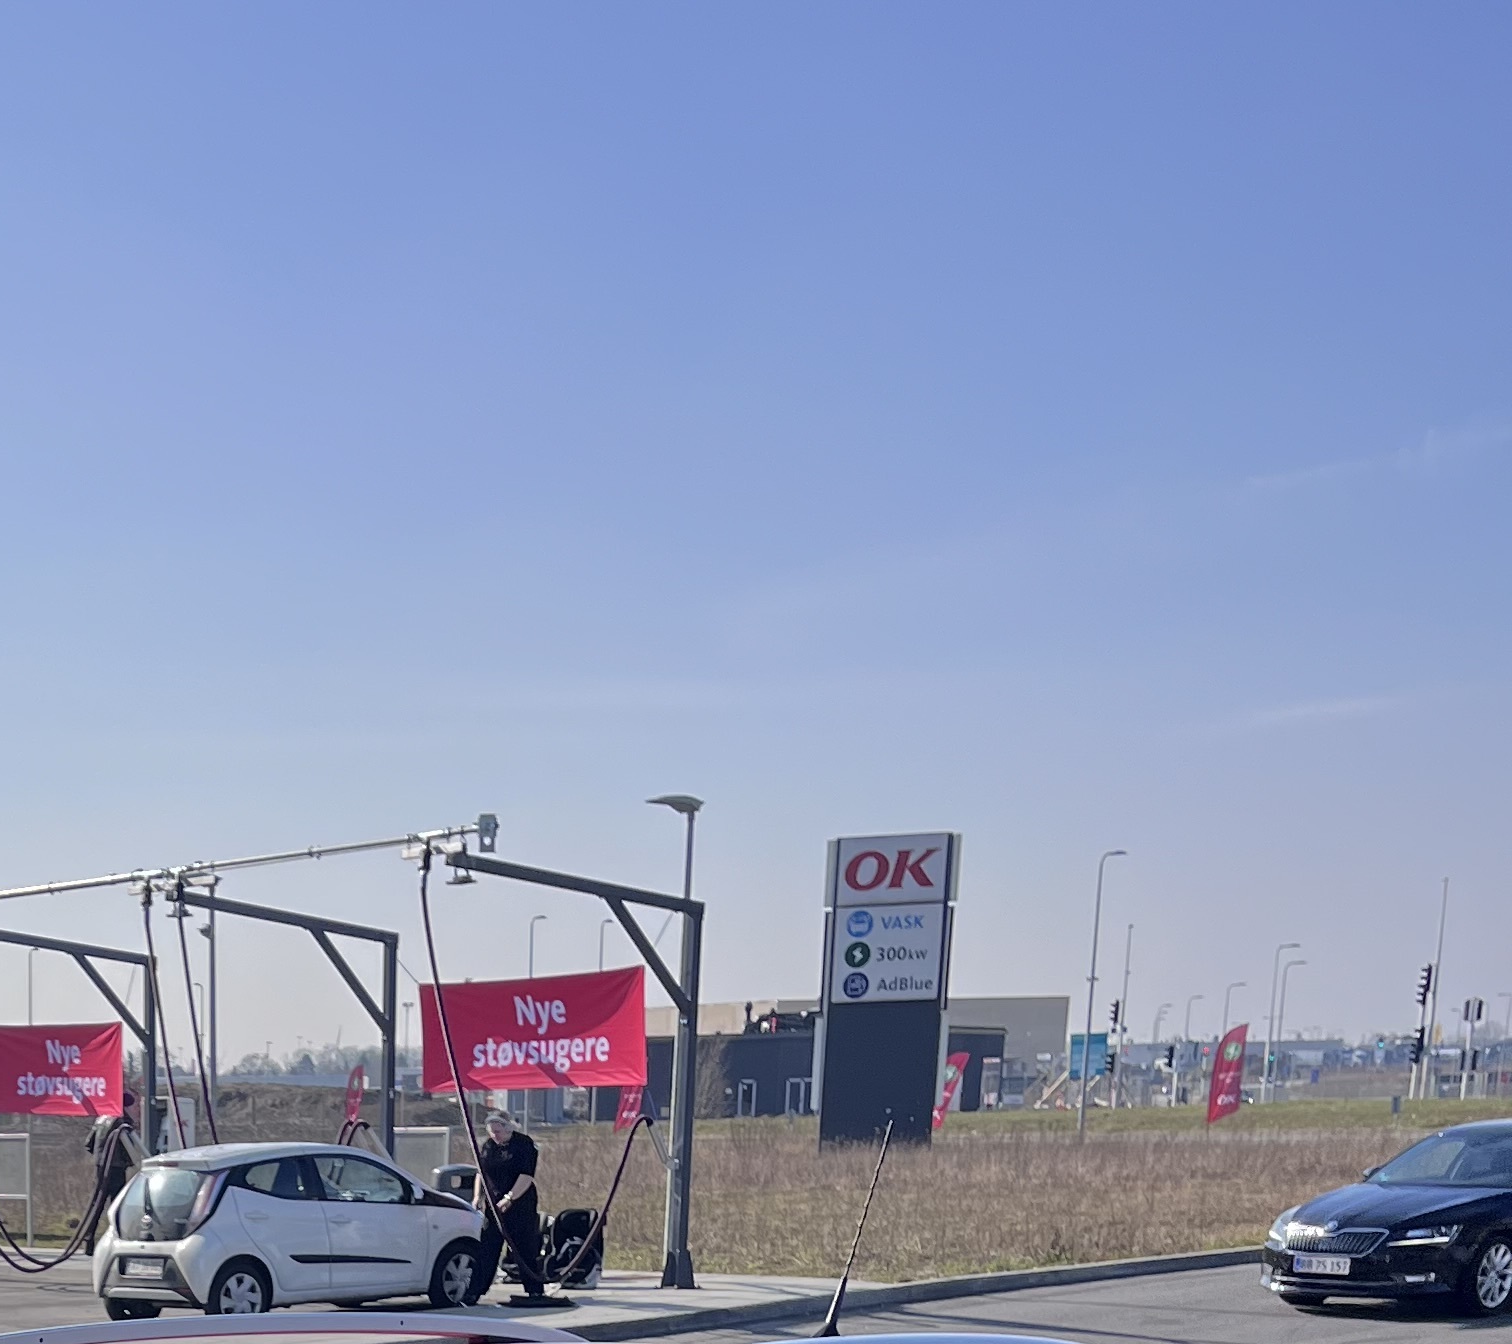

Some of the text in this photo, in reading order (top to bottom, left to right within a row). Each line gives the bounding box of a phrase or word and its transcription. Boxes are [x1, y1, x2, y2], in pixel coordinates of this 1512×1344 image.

[845, 847, 943, 891] OK
[881, 914, 924, 930] VASK
[877, 976, 933, 992] AdBlue
[512, 994, 567, 1035] Nye
[45, 1039, 82, 1071] Nye
[472, 1035, 610, 1073] støvsugere
[16, 1072, 107, 1104] støvsugere
